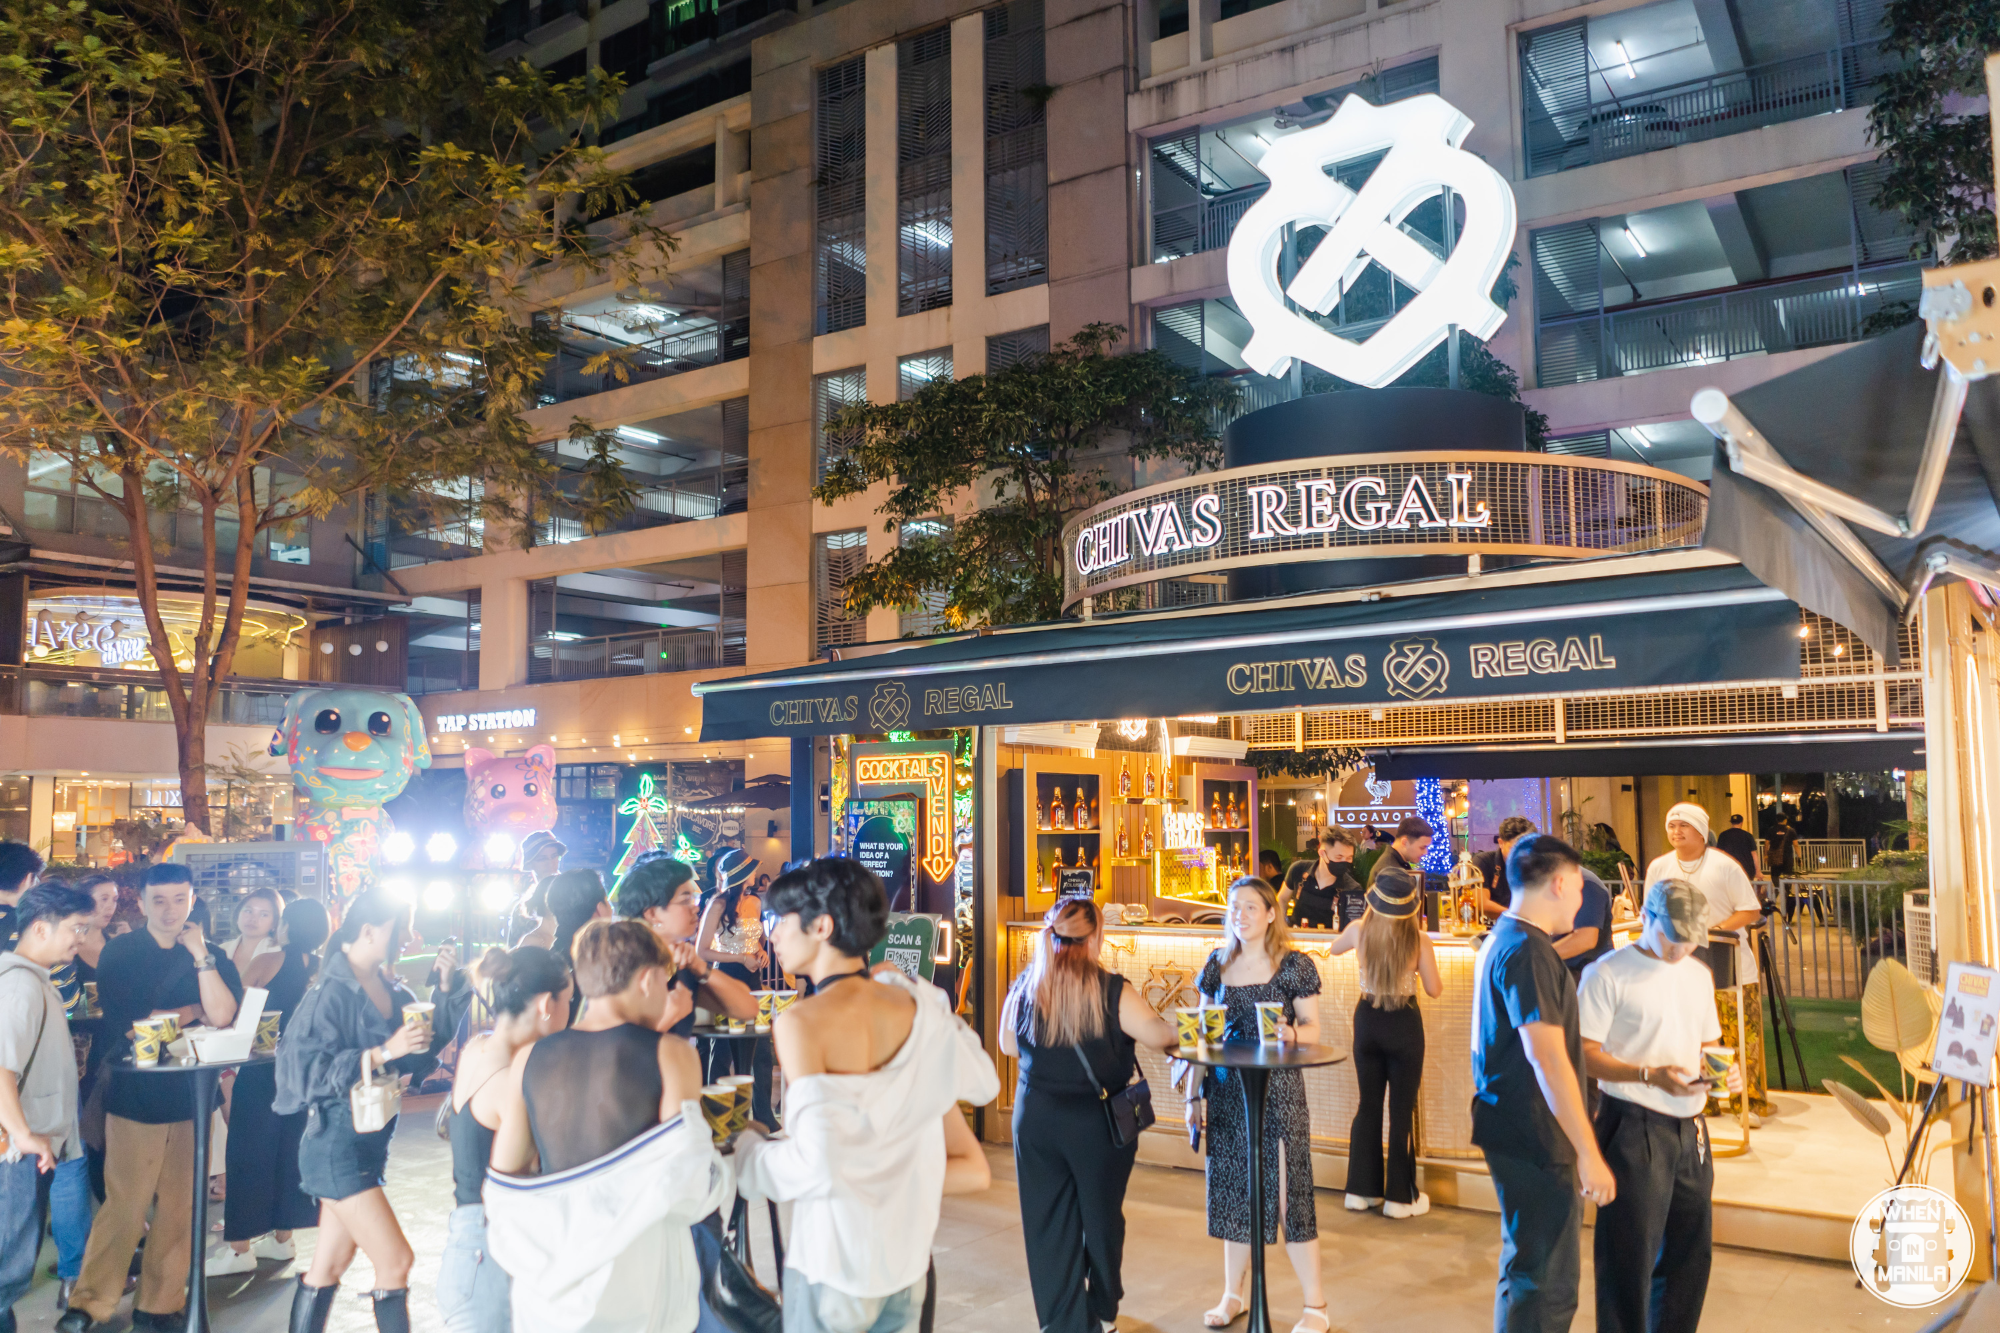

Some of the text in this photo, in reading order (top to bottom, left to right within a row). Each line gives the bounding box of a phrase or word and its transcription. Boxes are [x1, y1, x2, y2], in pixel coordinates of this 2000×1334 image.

[1075, 473, 1491, 576] CHIVAS REGAL
[1226, 634, 1617, 695] CHIVAS REGAL
[769, 682, 1013, 727] CHIVAS REGAL
[437, 708, 536, 732] TAP STATION
[860, 758, 943, 779] COCKTAILS
[931, 777, 943, 875] VENDO
[1336, 811, 1412, 822] LOCAVOR
[885, 843, 904, 851] YOUR
[860, 861, 888, 869] PERFECT
[887, 934, 922, 946] SCAN &
[1960, 973, 1990, 988] CHIVAS
